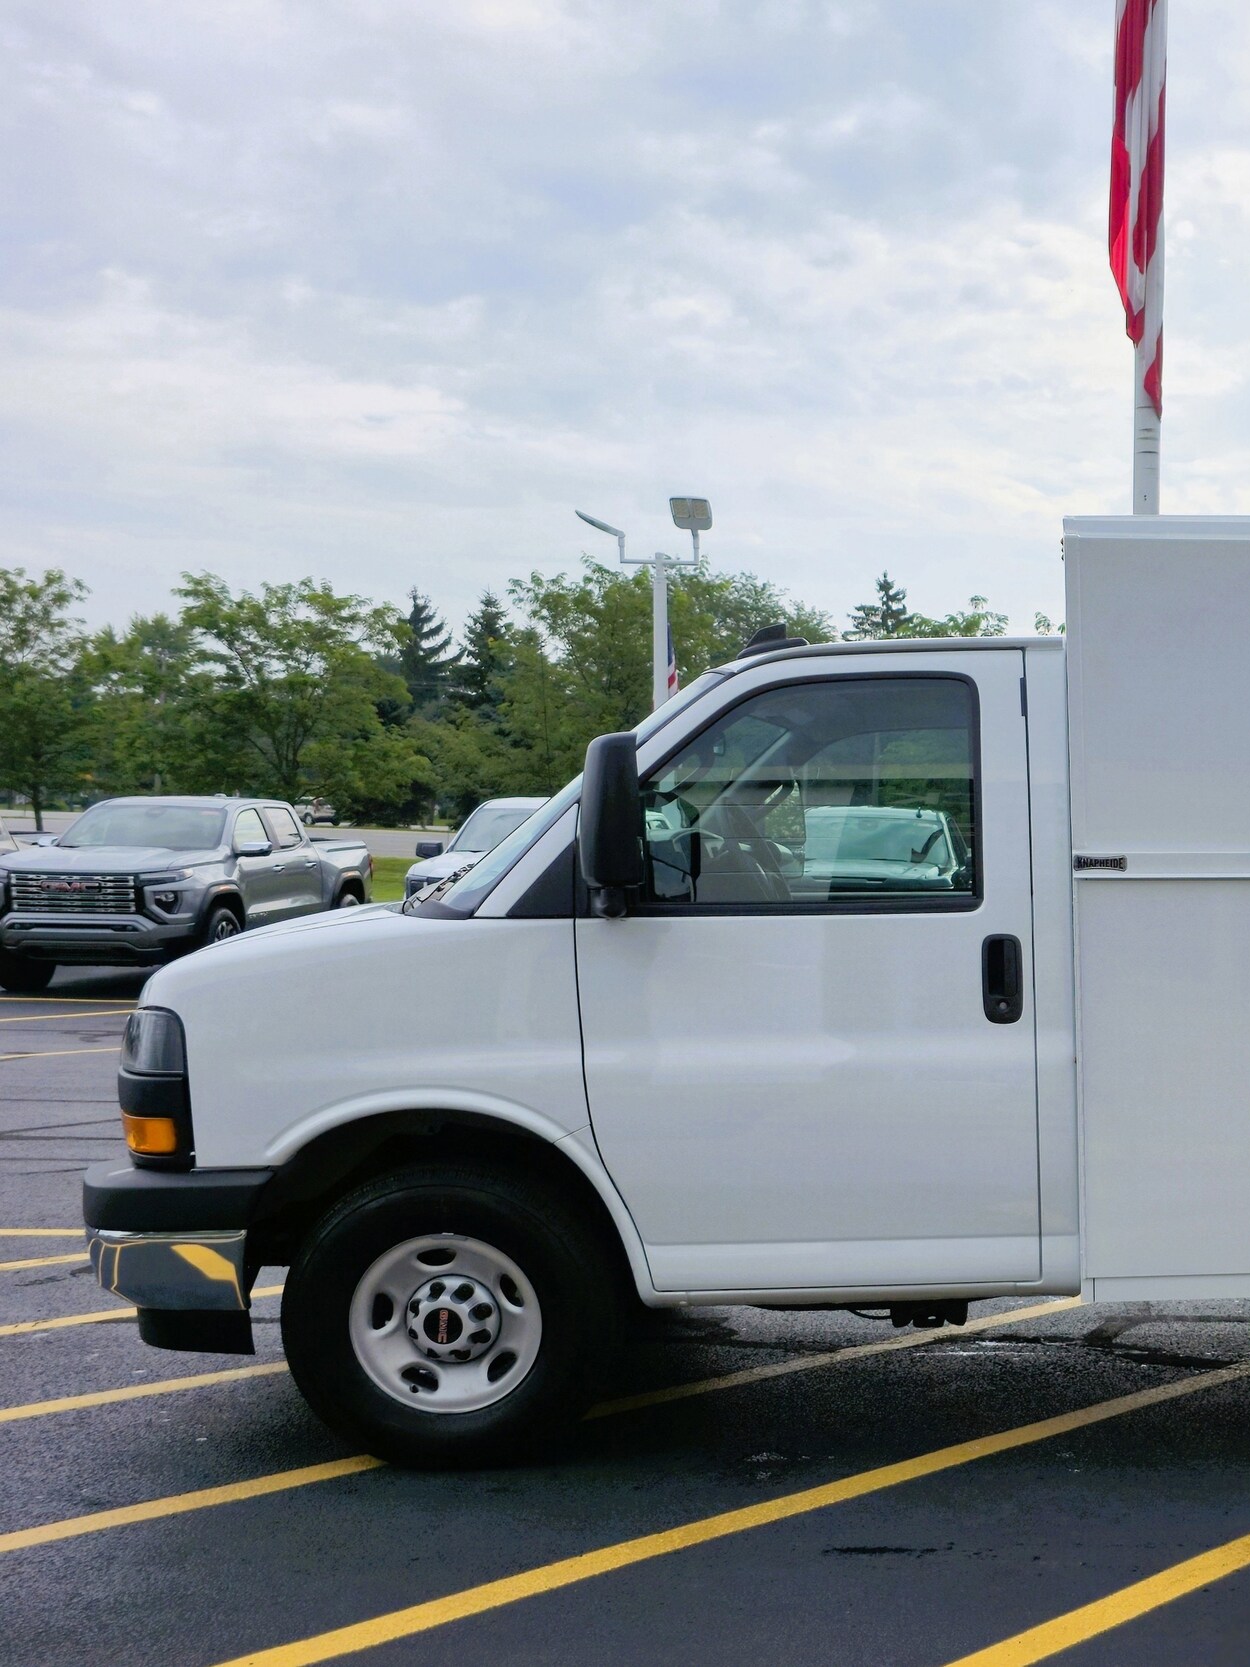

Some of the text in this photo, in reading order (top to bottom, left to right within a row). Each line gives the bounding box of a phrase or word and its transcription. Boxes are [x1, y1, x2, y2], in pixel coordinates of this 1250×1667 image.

[1077, 856, 1124, 869] KNAPHEIDE
[41, 881, 101, 893] GMC
[438, 1309, 449, 1343] GMC
